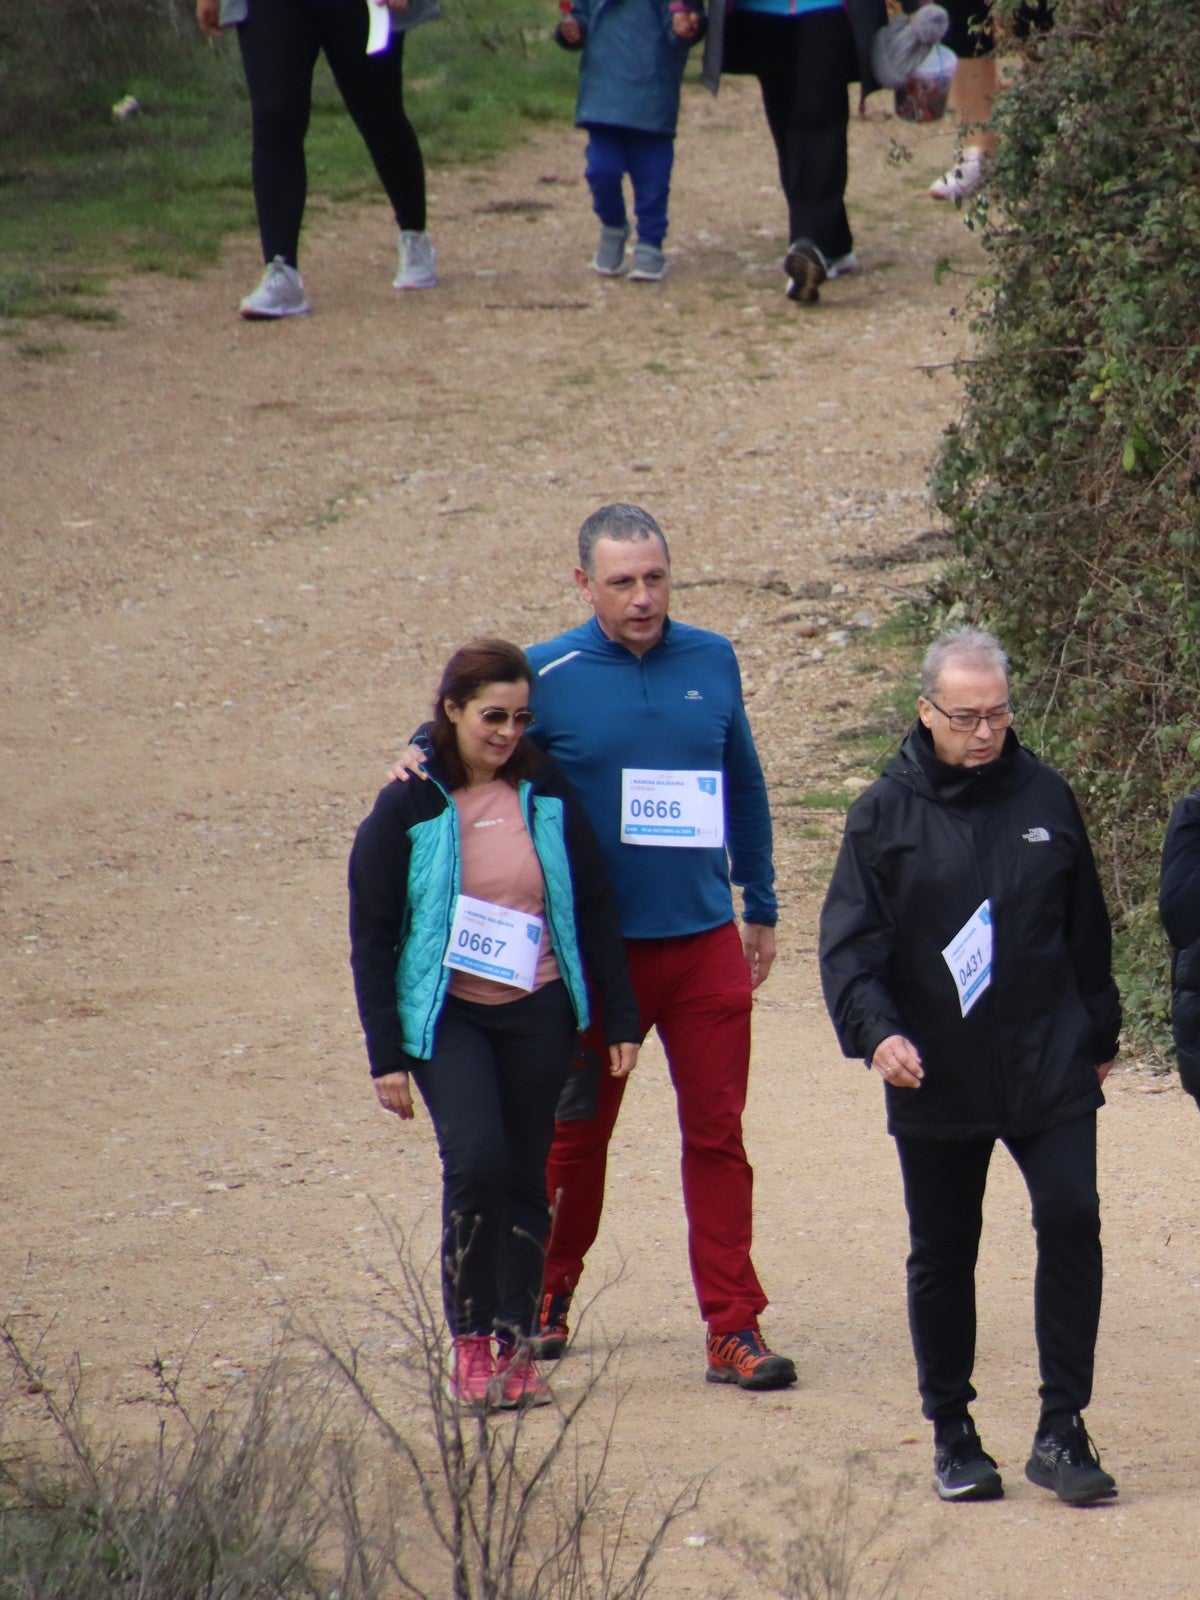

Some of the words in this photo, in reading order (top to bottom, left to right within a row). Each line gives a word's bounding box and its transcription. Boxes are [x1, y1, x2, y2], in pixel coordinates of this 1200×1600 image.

[631, 799, 681, 819] 0666
[458, 929, 507, 958] 0667
[959, 947, 983, 987] 0431
